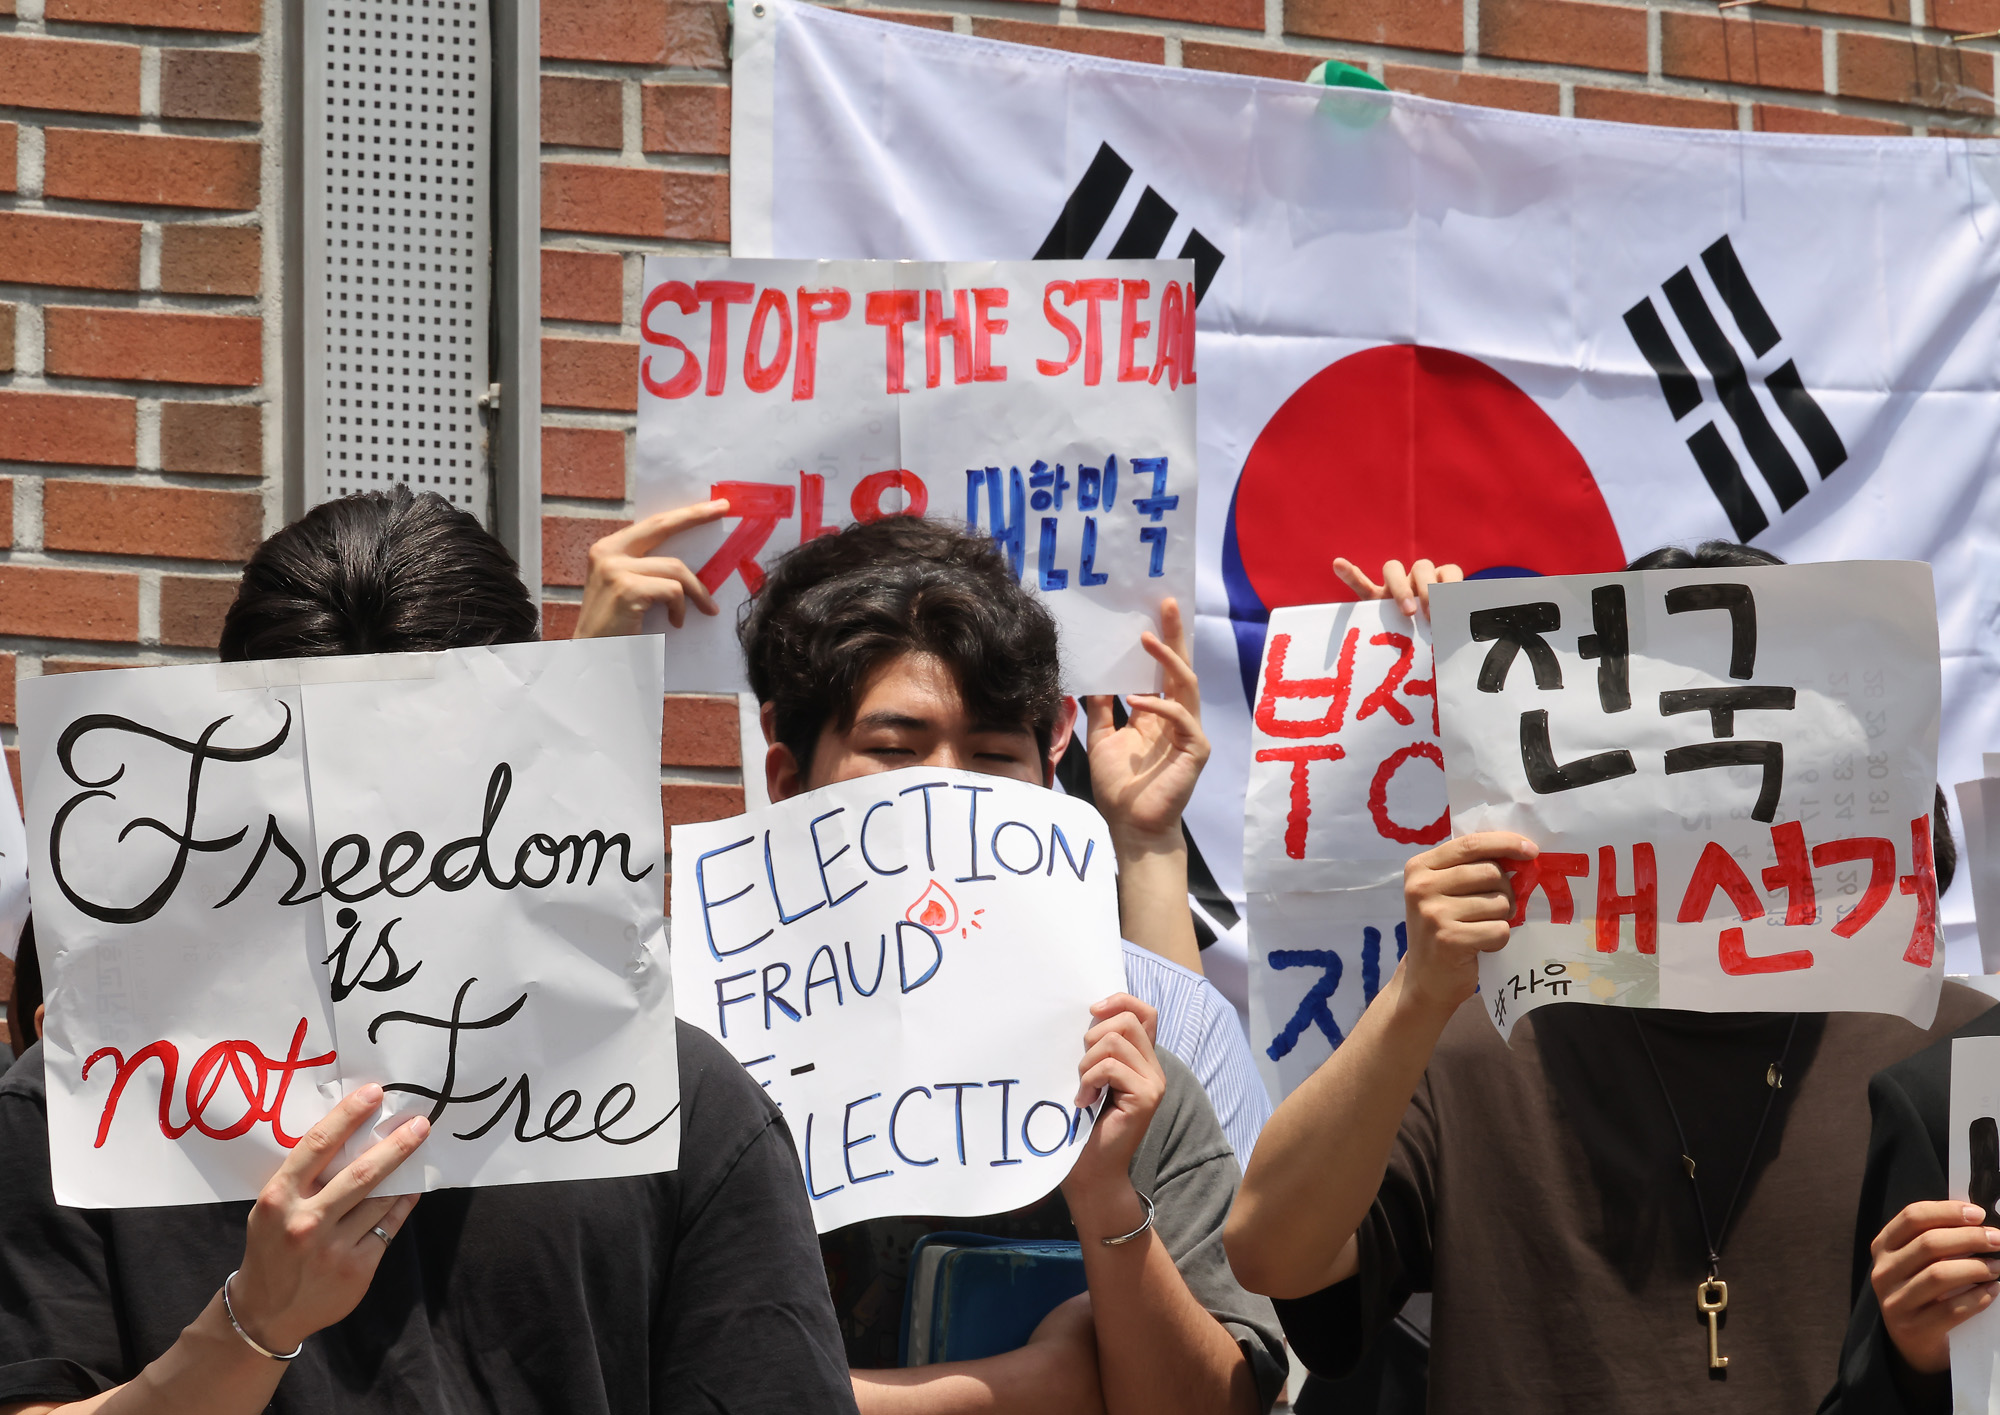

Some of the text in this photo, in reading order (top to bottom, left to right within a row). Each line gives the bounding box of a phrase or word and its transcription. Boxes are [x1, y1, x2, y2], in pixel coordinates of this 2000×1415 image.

[641, 280, 851, 401] STOP
[865, 287, 1009, 394] THE
[1470, 583, 1796, 823] 전국
[50, 699, 654, 924] Freedom
[695, 782, 1094, 962] ELECTION
[322, 907, 422, 1002] is
[1502, 813, 1936, 977] 재선거
[714, 920, 943, 1038] FRAUD
[1495, 963, 1572, 1026] #자유
[82, 977, 681, 1149] not Free
